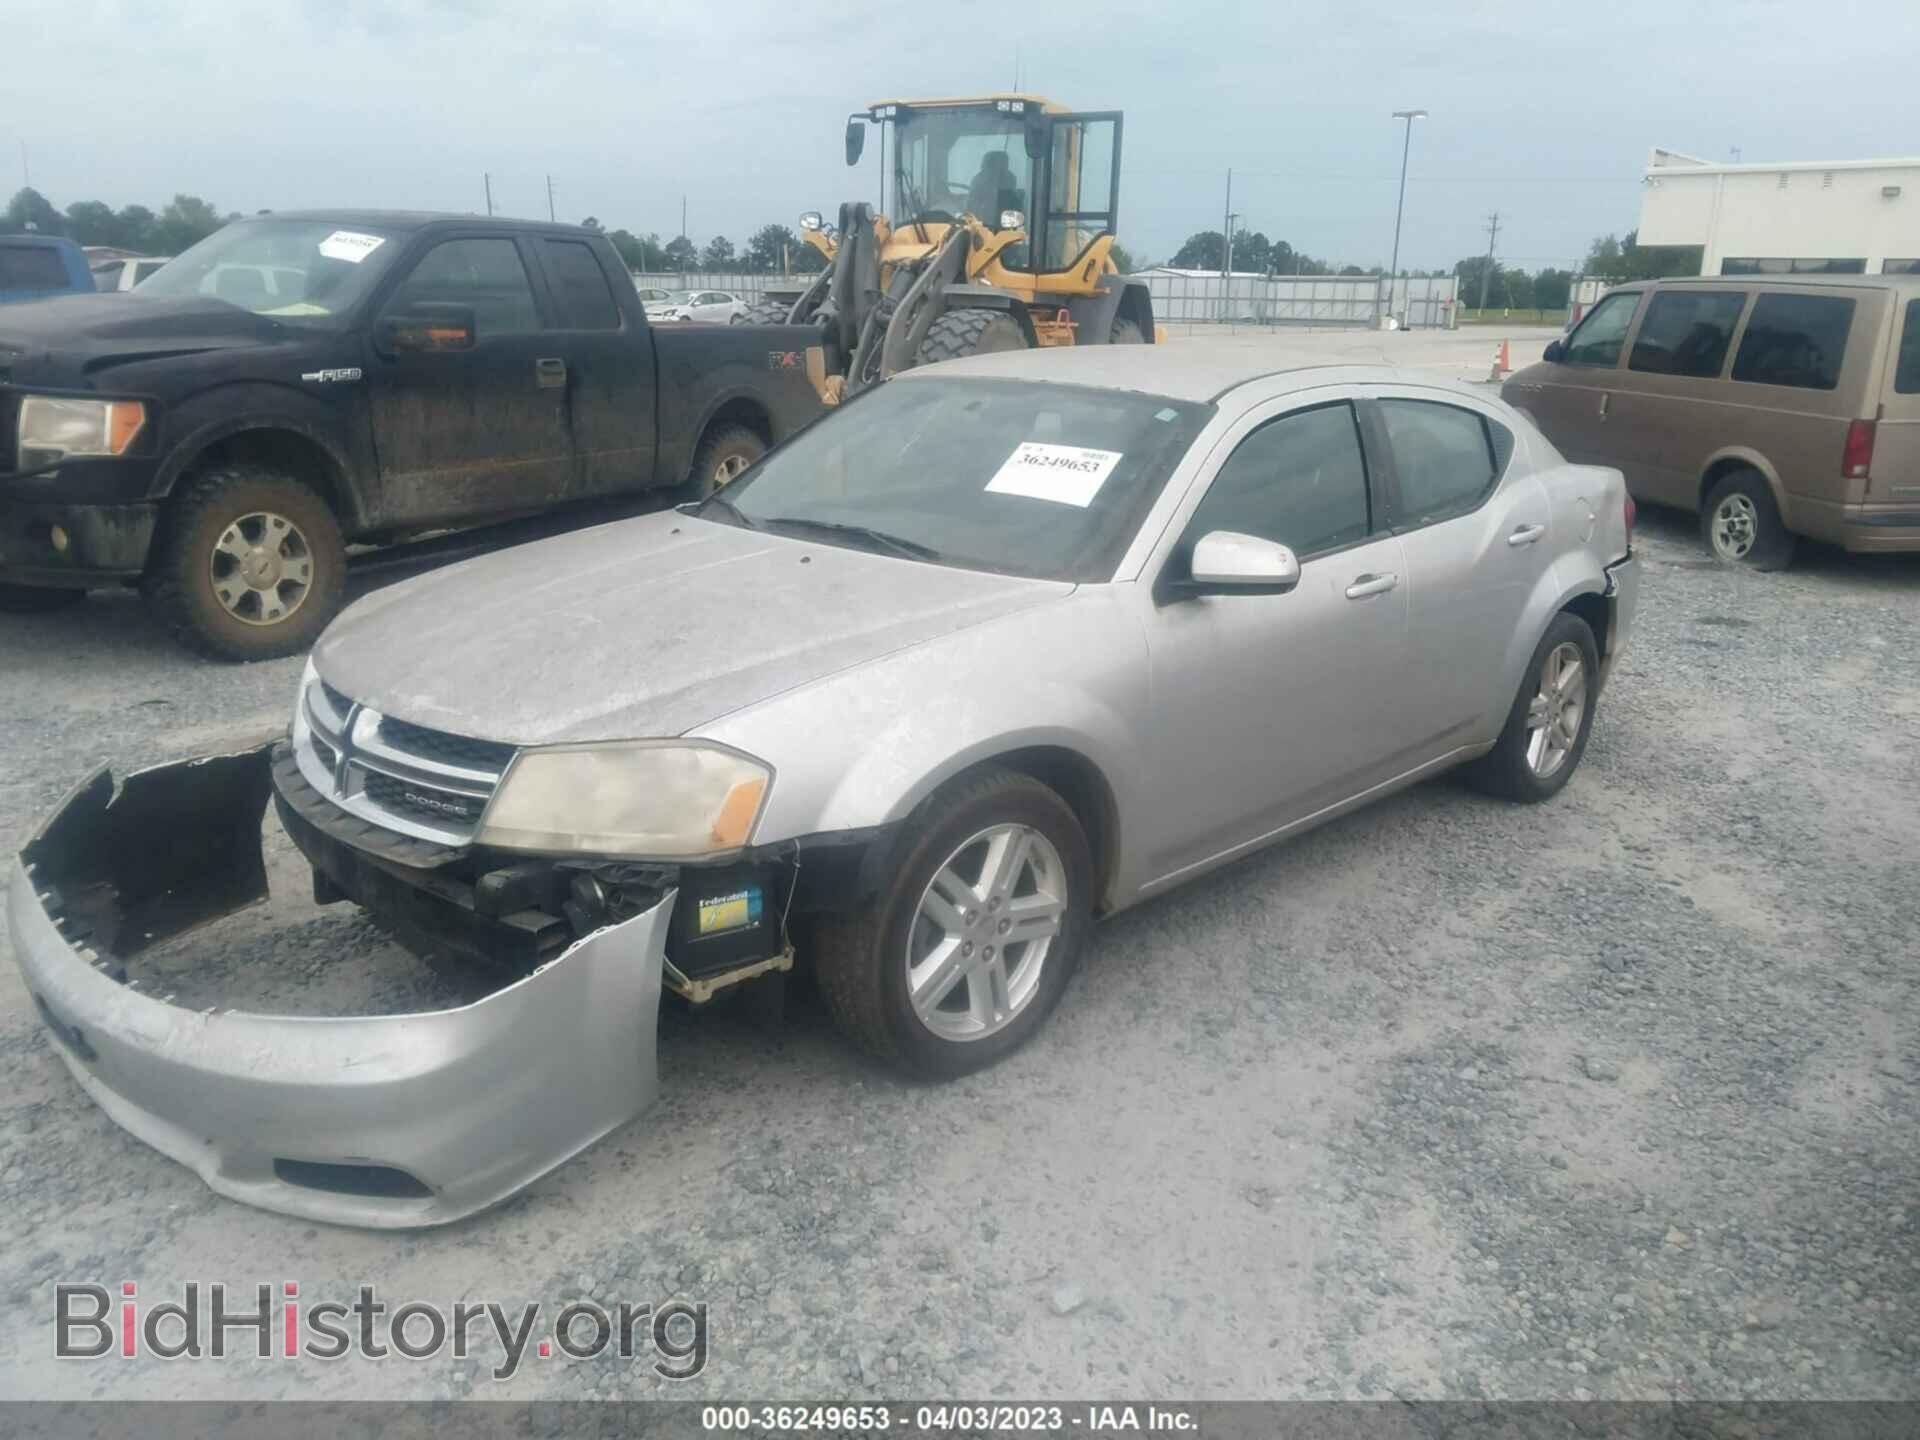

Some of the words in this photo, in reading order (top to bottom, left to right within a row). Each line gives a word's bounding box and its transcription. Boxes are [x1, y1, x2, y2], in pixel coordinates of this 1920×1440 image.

[1017, 453, 1100, 473] 36249653
[405, 792, 468, 815] DODGE
[699, 890, 748, 907] Federated
